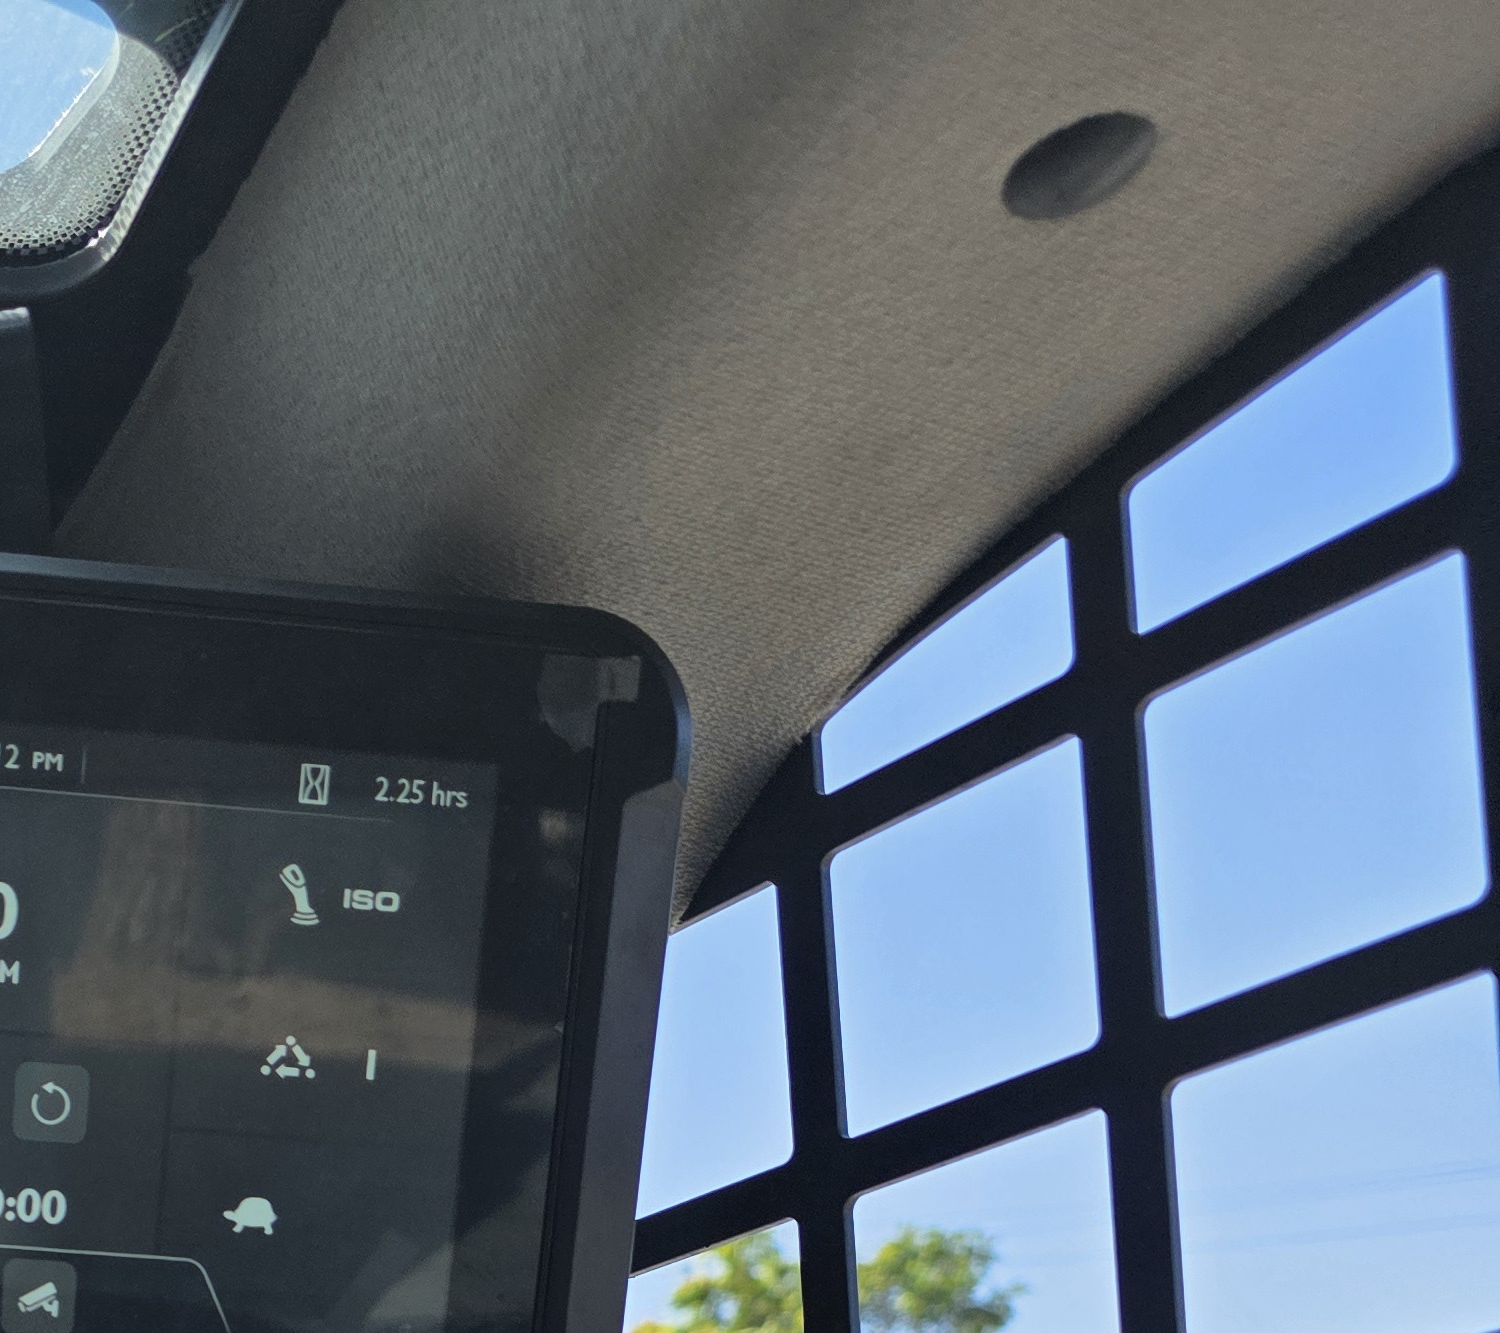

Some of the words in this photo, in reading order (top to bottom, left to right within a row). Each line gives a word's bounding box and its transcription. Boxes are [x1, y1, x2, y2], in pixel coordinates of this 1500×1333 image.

[32, 750, 64, 772] PM
[374, 777, 424, 804] 2.25
[431, 782, 469, 809] hrs
[343, 888, 400, 912] ISO
